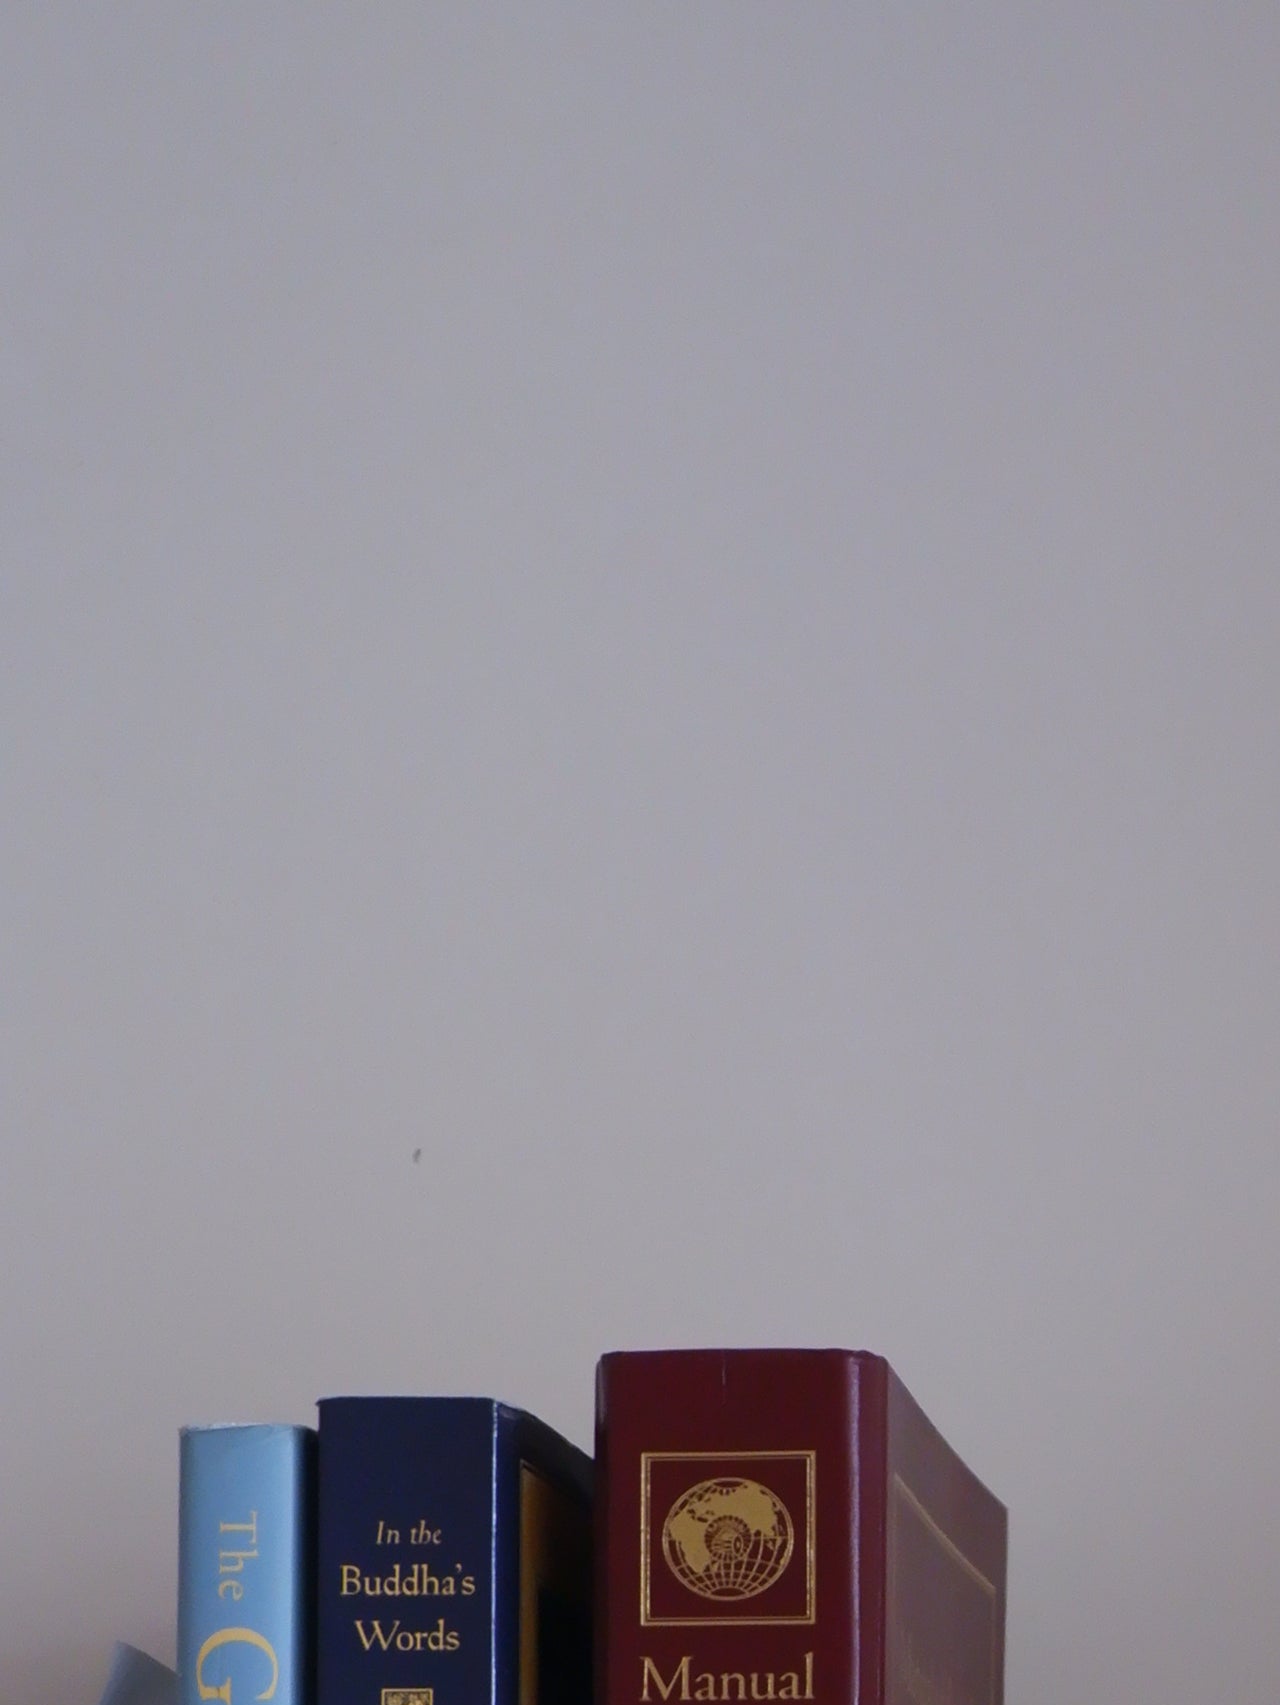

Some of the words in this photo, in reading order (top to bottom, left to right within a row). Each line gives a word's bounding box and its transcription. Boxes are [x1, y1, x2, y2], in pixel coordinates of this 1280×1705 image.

[376, 1520, 400, 1545] In
[410, 1519, 442, 1545] the
[218, 1509, 258, 1601] The
[340, 1563, 476, 1596] Buddha's
[354, 1618, 460, 1651] Words
[639, 1651, 814, 1701] Manual
